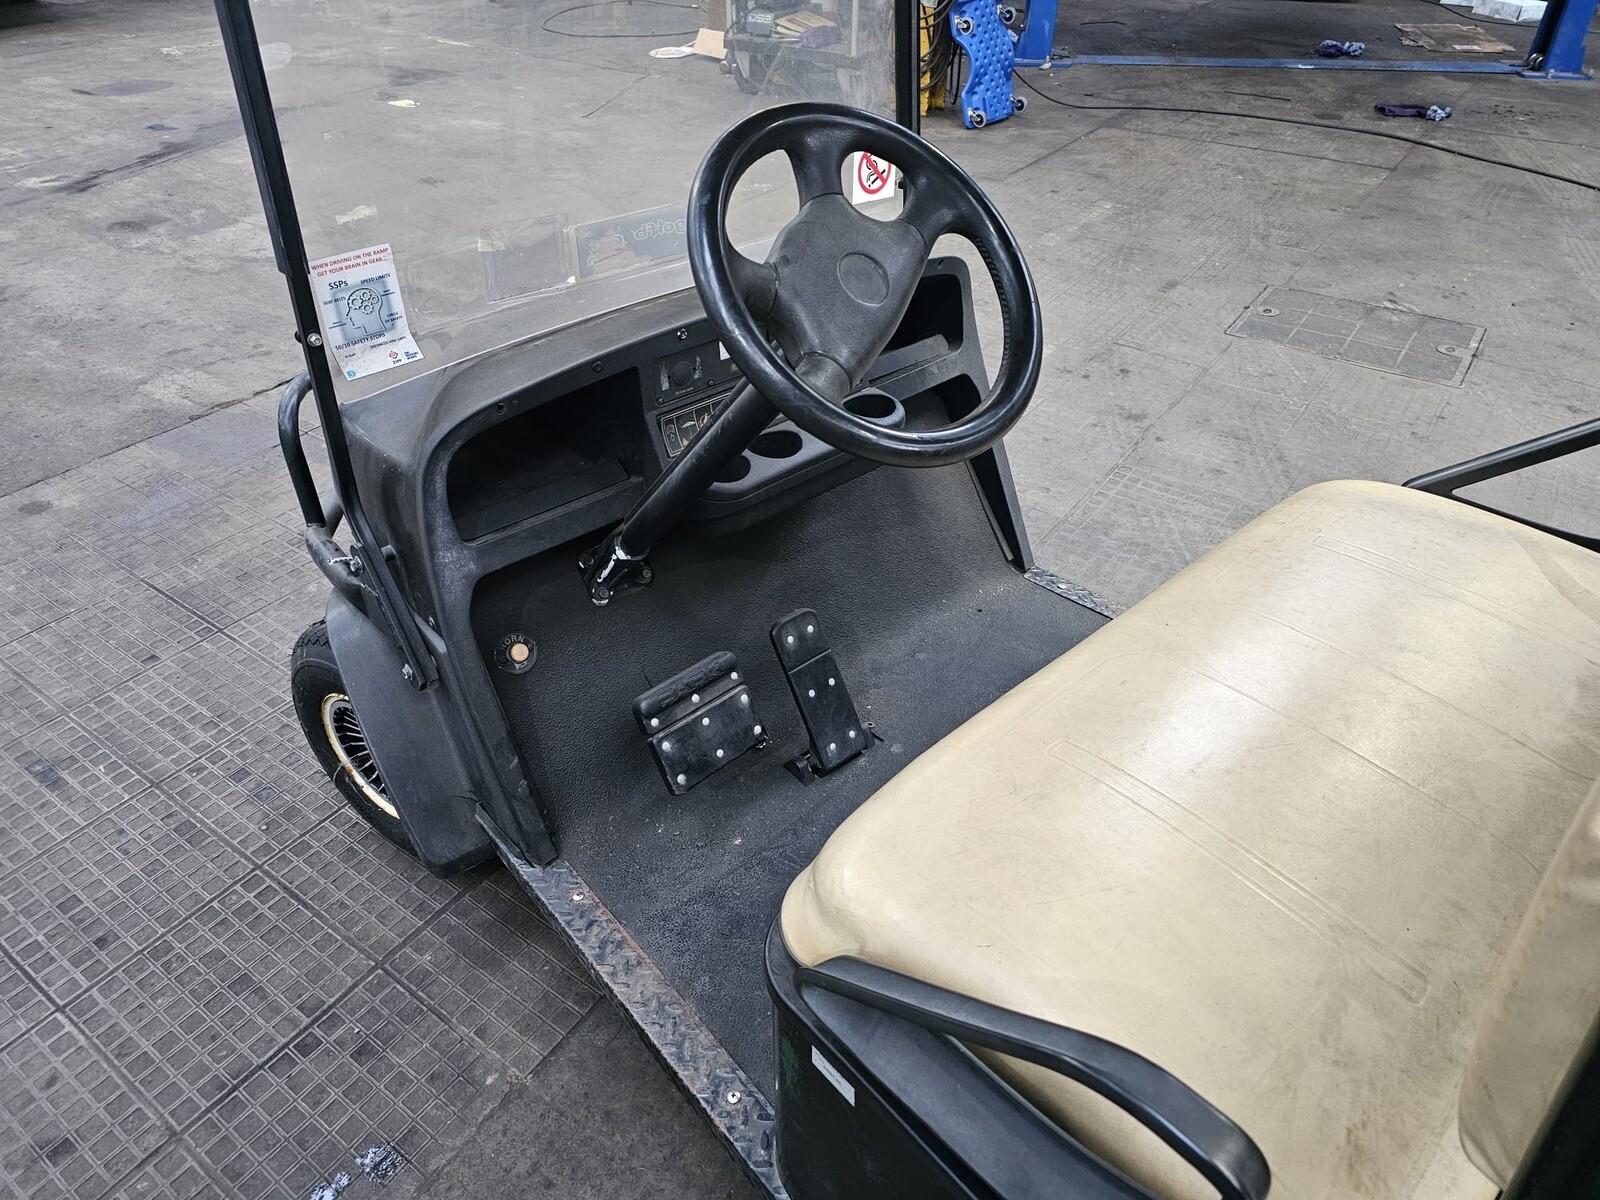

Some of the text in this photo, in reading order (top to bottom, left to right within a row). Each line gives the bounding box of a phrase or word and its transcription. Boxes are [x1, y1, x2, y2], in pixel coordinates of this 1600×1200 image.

[311, 262, 328, 270] WHEN
[329, 257, 352, 266] DRIVING
[373, 248, 388, 256] RAMP
[328, 266, 344, 275] YOUR
[375, 273, 391, 281] LIMITS
[328, 280, 348, 290] SSPs
[335, 342, 351, 351] 50/10
[351, 337, 369, 347] SAFETY
[500, 634, 525, 651] HORN
